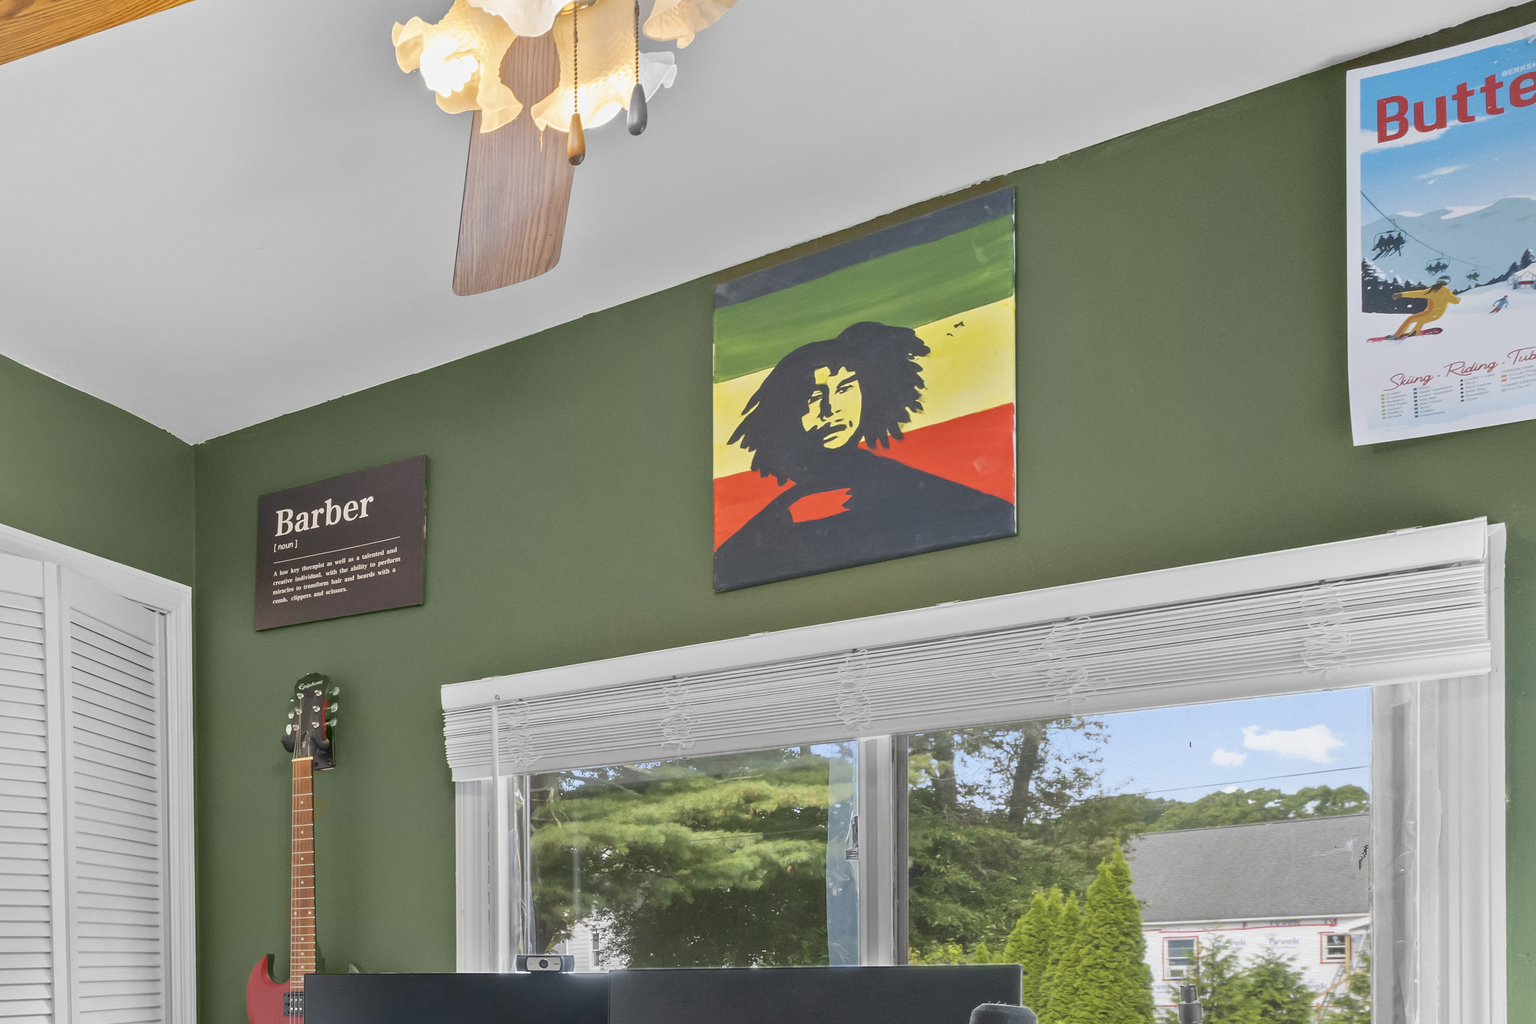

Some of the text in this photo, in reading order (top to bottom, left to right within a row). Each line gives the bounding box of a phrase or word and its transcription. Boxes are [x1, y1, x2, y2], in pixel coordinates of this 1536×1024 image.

[1377, 71, 1536, 143] Butte
[1383, 372, 1434, 392] Skiing
[1443, 360, 1499, 378] Riding
[275, 495, 374, 537] Barber
[272, 578, 293, 586] creative
[350, 563, 368, 572] ability
[377, 556, 401, 567] perform
[301, 562, 325, 572] therapist
[361, 550, 385, 560] talented
[272, 587, 294, 595] miracles
[303, 580, 329, 590] transform
[330, 577, 343, 585] hair
[356, 571, 376, 580] beards
[377, 568, 390, 576] with
[290, 593, 312, 601] clippers
[1268, 937, 1300, 946] Tyvek
